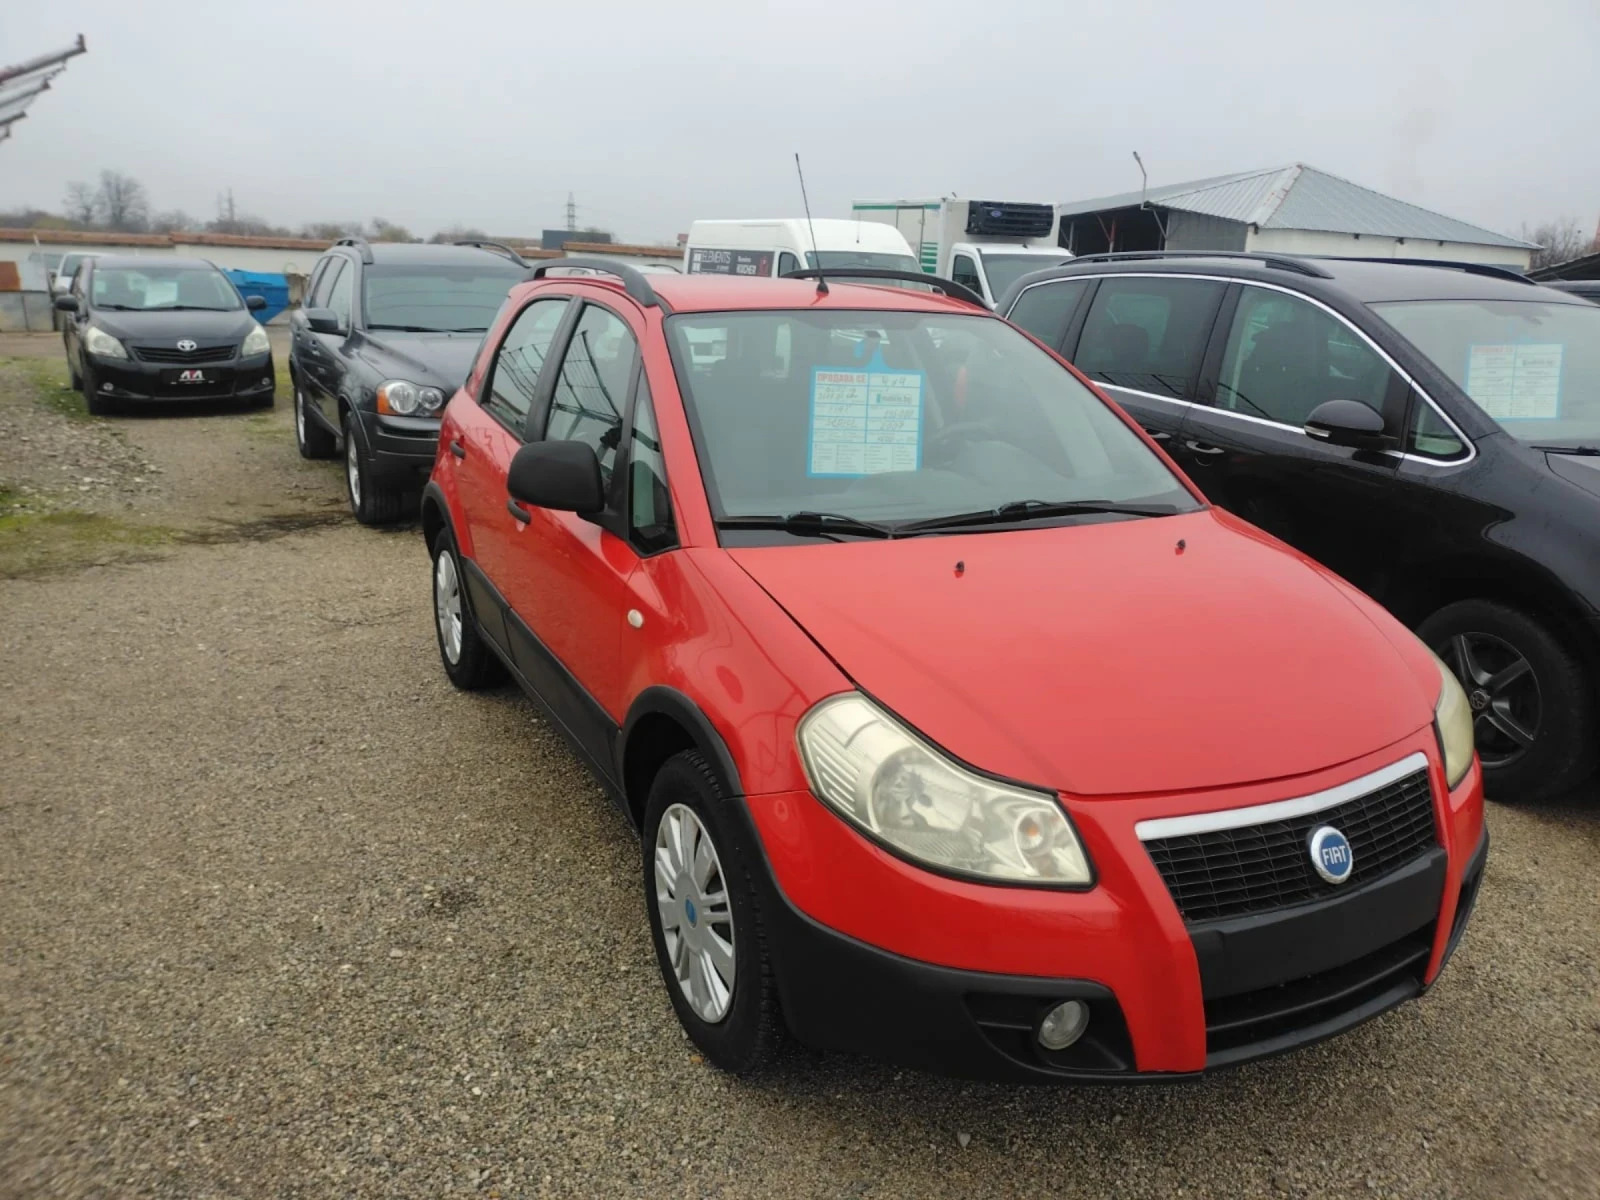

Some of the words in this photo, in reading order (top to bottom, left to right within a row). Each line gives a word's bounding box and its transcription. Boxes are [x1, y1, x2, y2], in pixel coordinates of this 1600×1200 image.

[817, 373, 854, 383] ПРОДАВА
[856, 374, 866, 384] СЕ
[1322, 845, 1347, 866] FIAT
